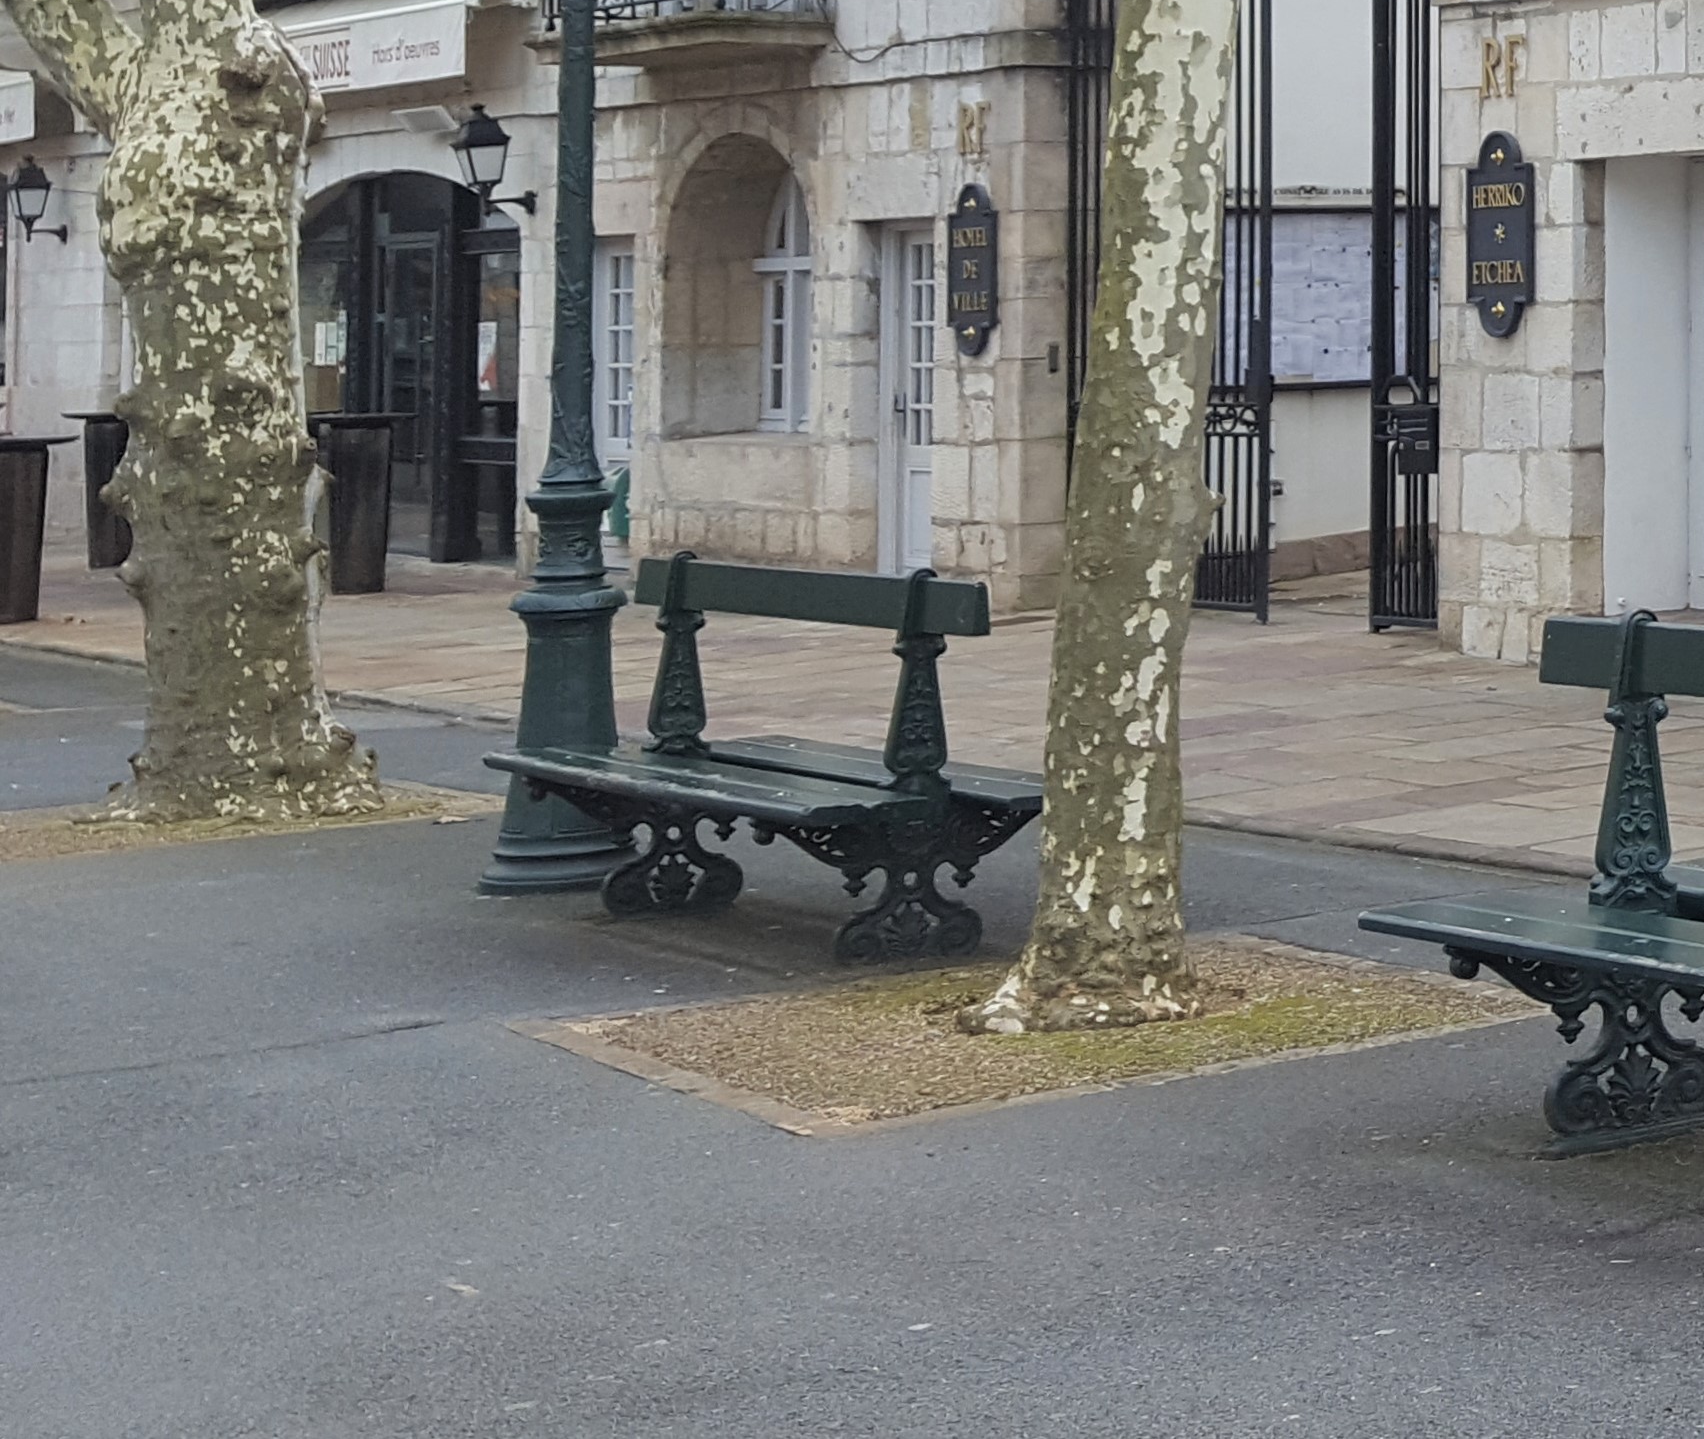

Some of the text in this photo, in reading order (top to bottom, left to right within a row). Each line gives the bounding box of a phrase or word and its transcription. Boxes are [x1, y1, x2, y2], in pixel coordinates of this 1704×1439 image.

[313, 40, 350, 80] SUISSE
[1480, 34, 1525, 99] RF
[957, 101, 991, 154] RF
[1472, 182, 1525, 209] HERRIKO
[962, 259, 979, 279] DE
[1472, 259, 1525, 284] ETCHEA
[952, 291, 989, 312] VILLE
